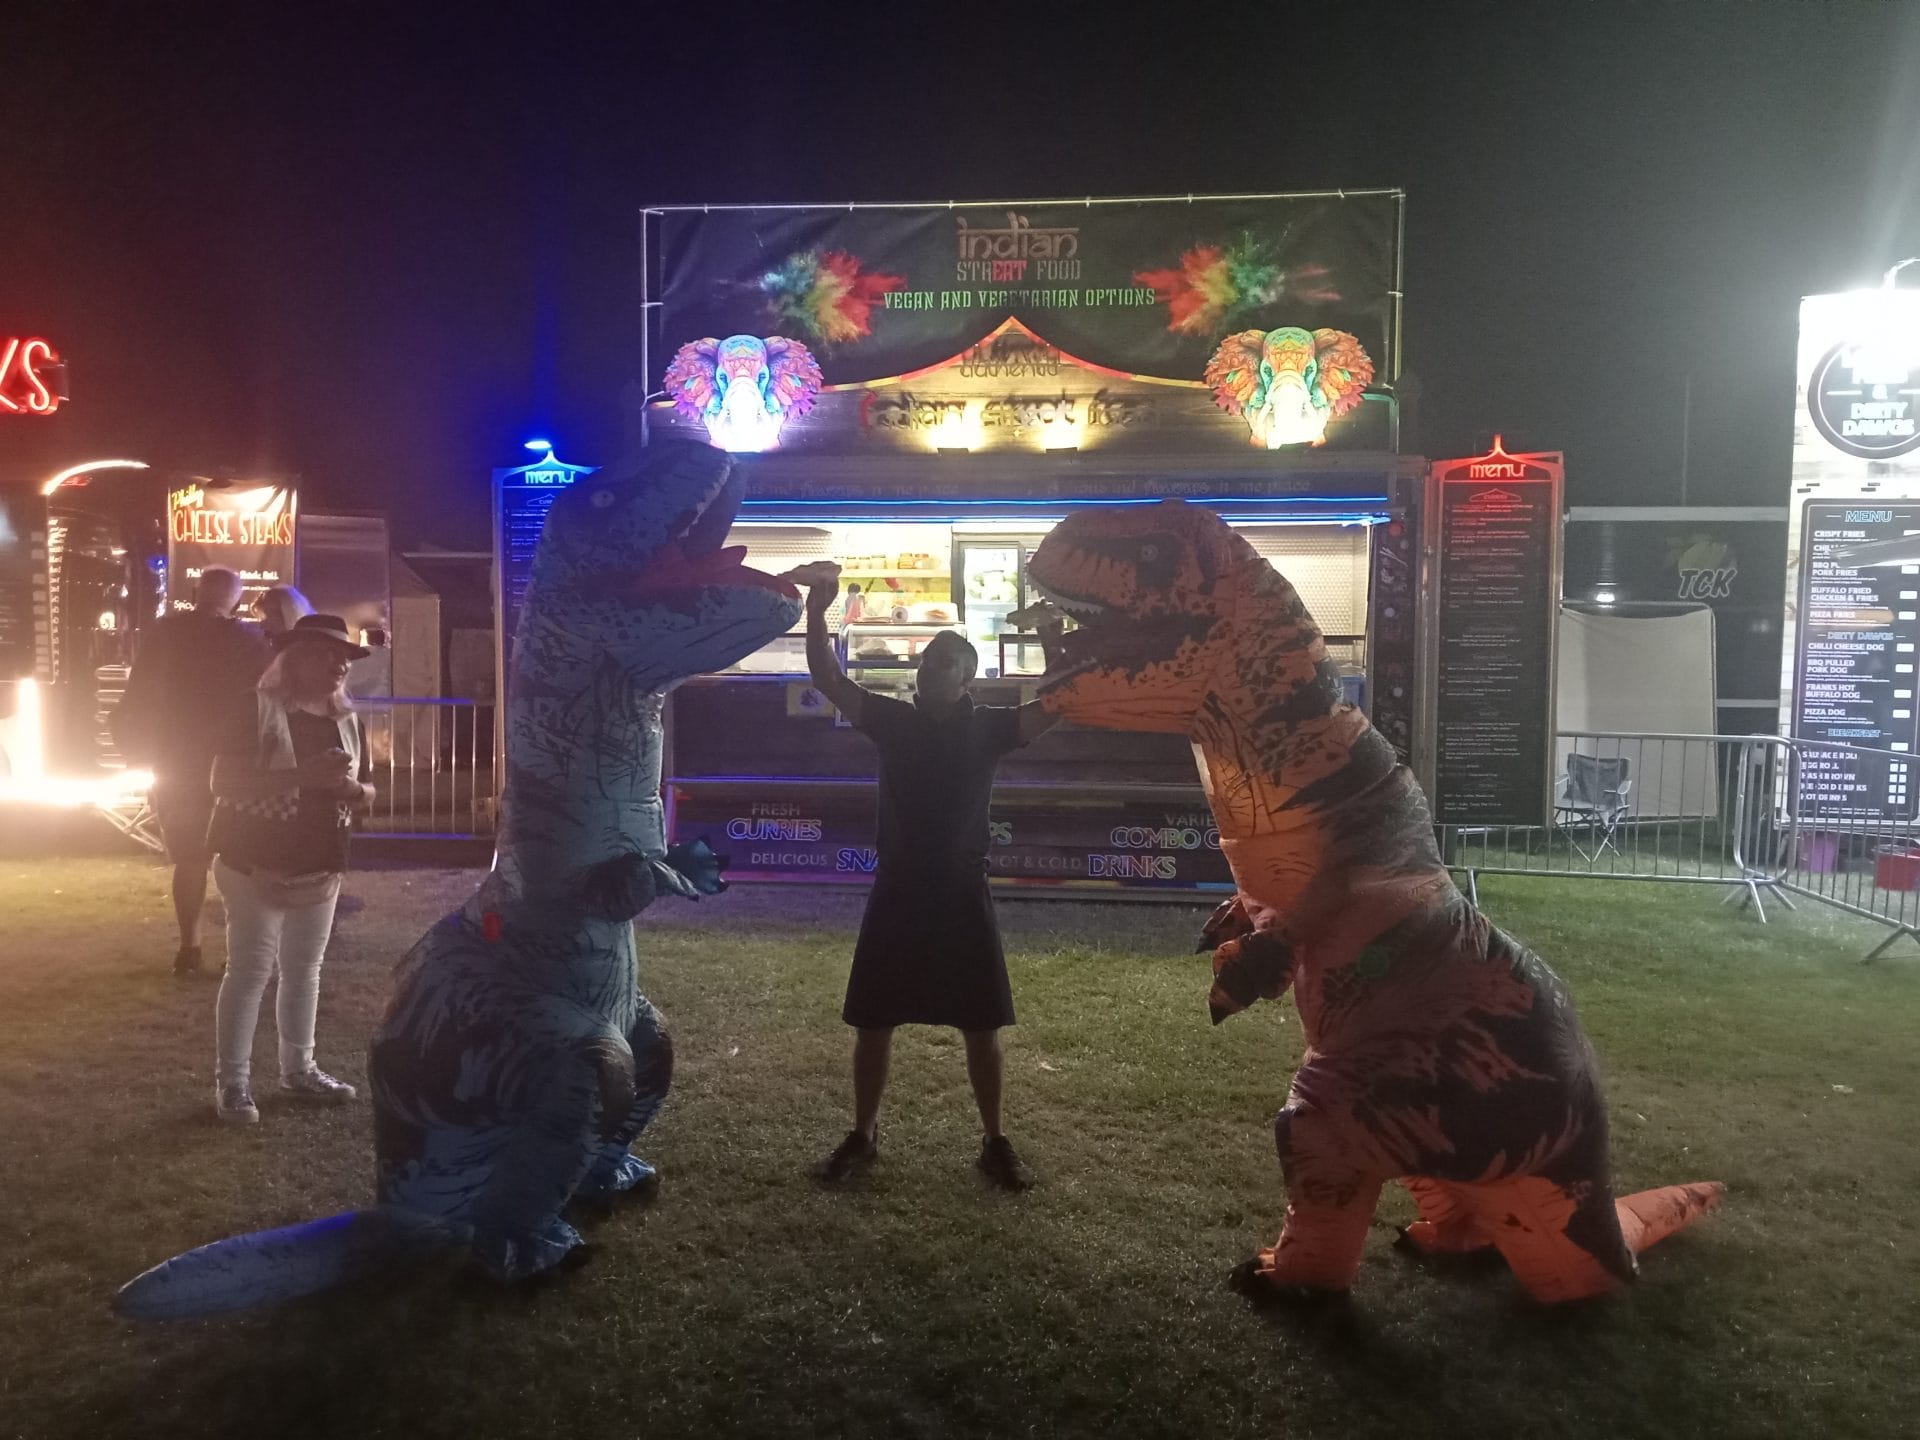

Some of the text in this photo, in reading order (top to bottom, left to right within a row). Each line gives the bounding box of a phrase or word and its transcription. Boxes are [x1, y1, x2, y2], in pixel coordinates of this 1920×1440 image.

[956, 211, 1080, 259] indian
[1037, 260, 1081, 281] FOOD
[883, 288, 1156, 311] VEGAN AND VEGETARIAN OPTIONS
[525, 470, 576, 484] menu
[1469, 463, 1526, 478] menu
[172, 484, 204, 511] Philly
[1845, 510, 1892, 522] MENU
[174, 510, 293, 544] CHEESE STEAKS
[1814, 530, 1866, 538] CRISPY FRIES
[1679, 568, 1738, 598] TCK
[1811, 586, 1872, 595] BUFFALO FRIED
[1810, 594, 1846, 602] CHICKEN
[1847, 594, 1855, 602] &
[1833, 611, 1856, 619] FRIES
[1834, 643, 1865, 651] CHEESE
[1866, 643, 1885, 651] DOG
[1806, 666, 1829, 674] PORK
[1807, 659, 1855, 667] BBQ PULLED
[1805, 683, 1856, 692] FRANKS HOT
[1805, 691, 1841, 699] BUFFALO
[1804, 708, 1827, 716] PIZZA
[1828, 728, 1881, 738] BREAKFAST
[751, 803, 801, 817] FRESH
[1164, 813, 1218, 828] VARIE
[727, 817, 822, 842] CURRIES
[1110, 826, 1202, 850] COMBO
[751, 852, 829, 867] DELICIOUS
[1038, 856, 1082, 870] COLD
[1088, 853, 1178, 879] DRINKS
